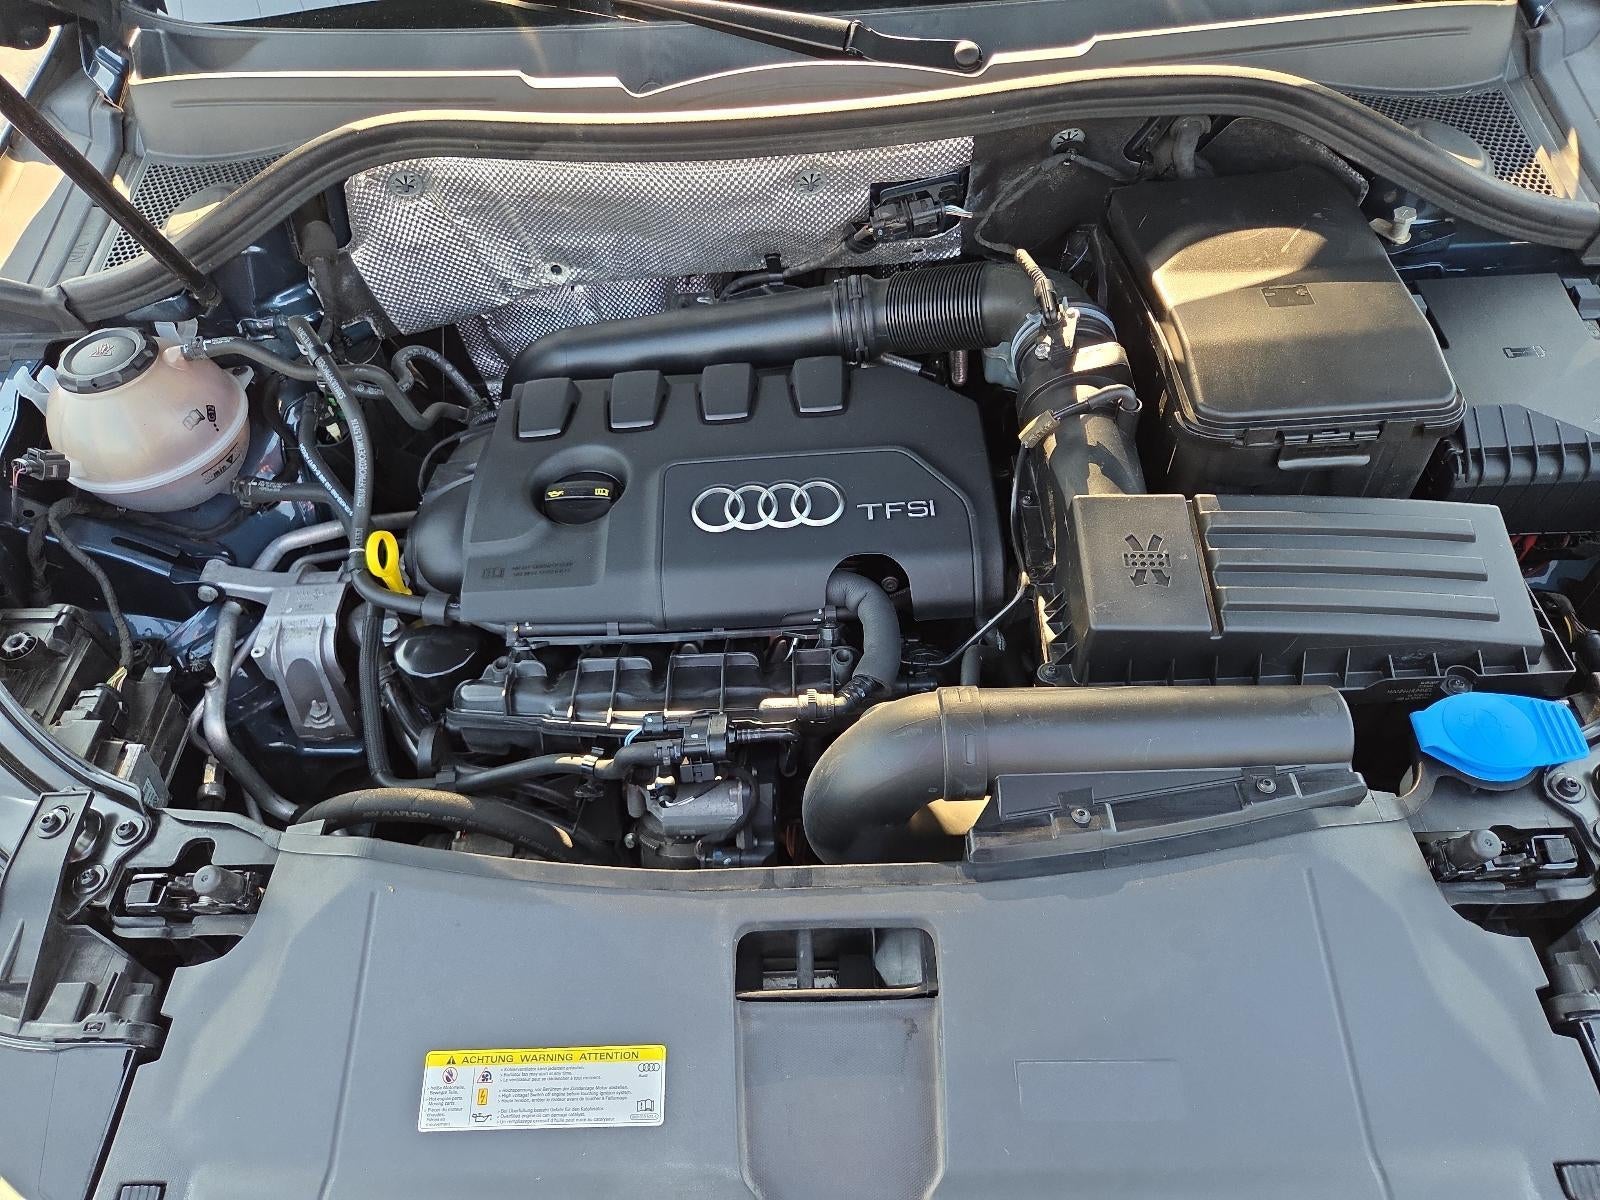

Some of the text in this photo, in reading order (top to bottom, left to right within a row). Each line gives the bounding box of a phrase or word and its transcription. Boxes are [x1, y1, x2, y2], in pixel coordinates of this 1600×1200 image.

[213, 465, 228, 479] min
[857, 499, 936, 520] TFSI
[461, 1051, 639, 1064] ACHTUNG WARNING ATTENTION
